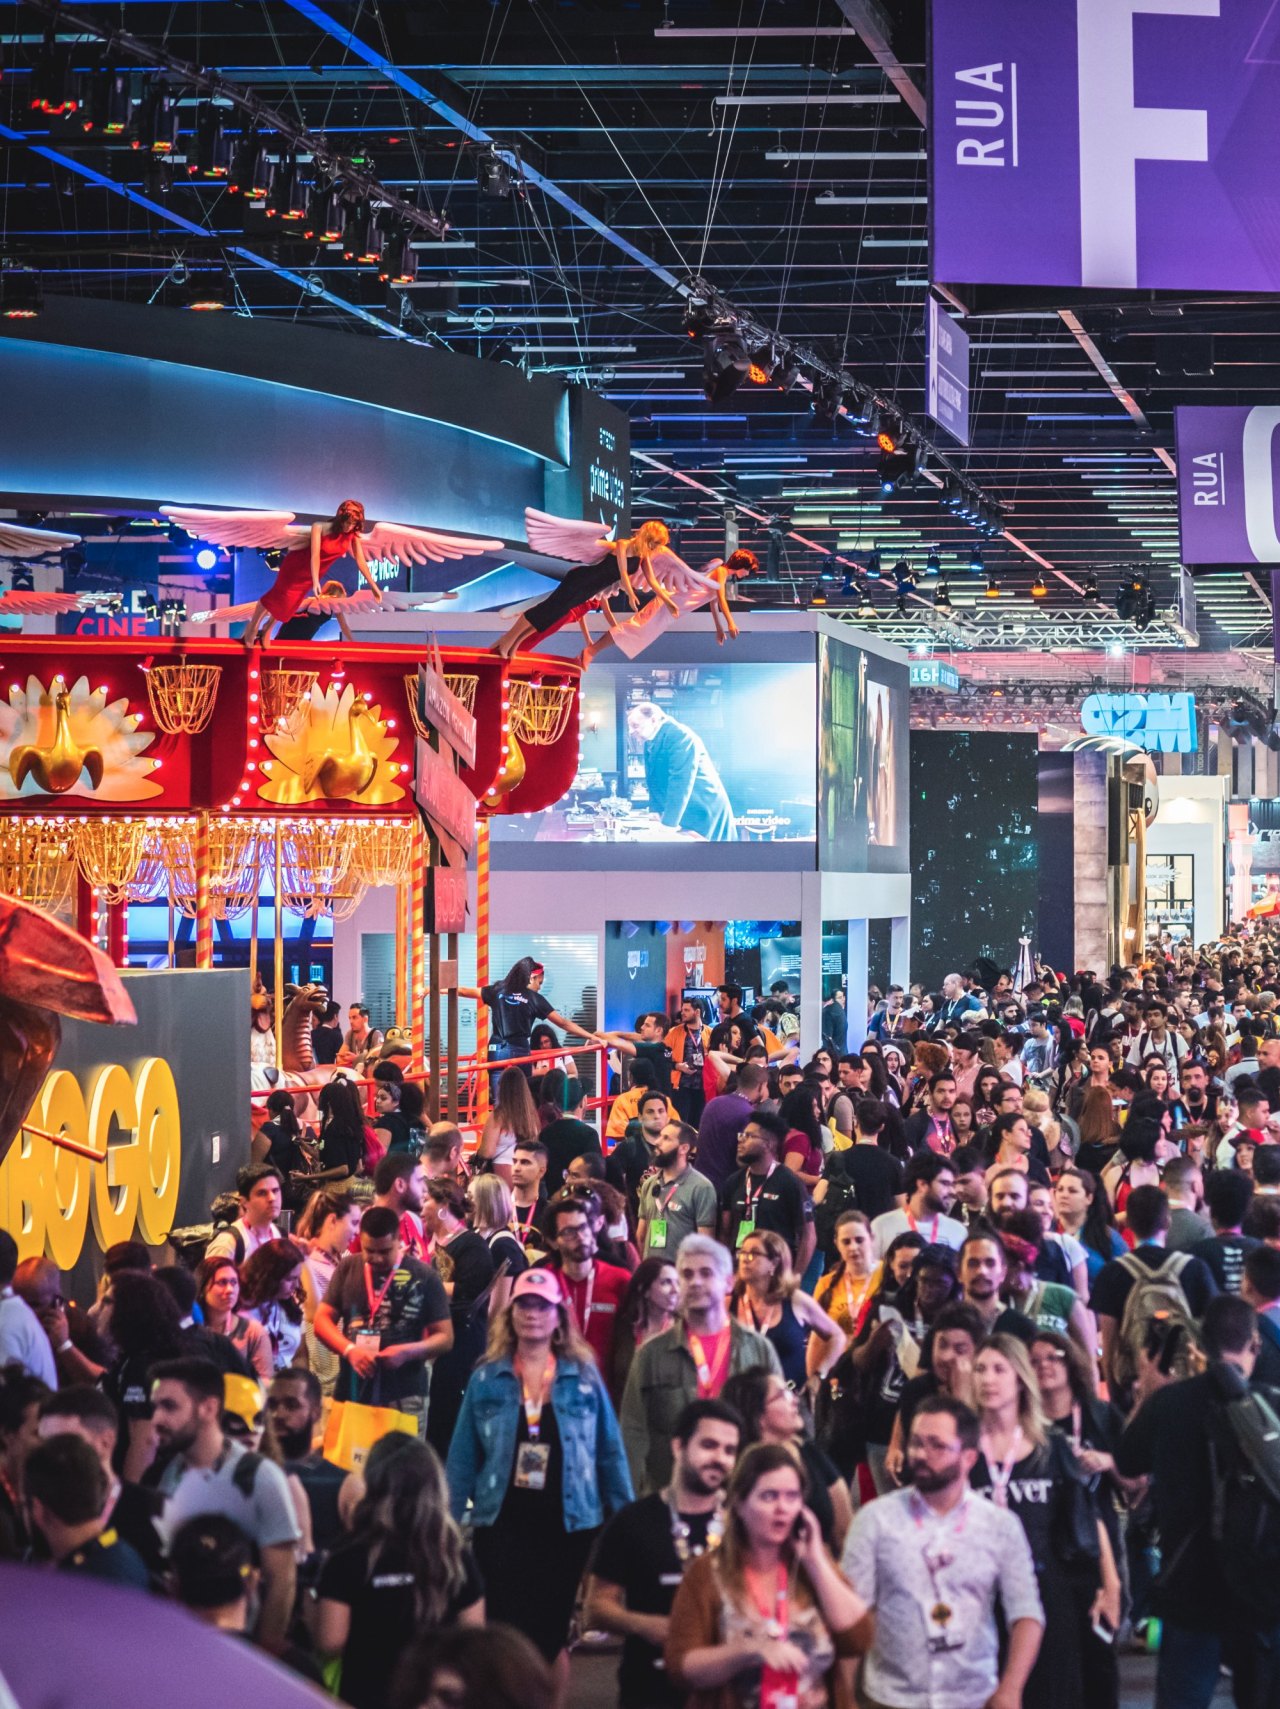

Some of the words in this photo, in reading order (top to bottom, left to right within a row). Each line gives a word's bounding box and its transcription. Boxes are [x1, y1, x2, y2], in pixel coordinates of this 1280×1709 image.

[955, 62, 1005, 167] RUA
[1077, 0, 1221, 288] F
[1193, 452, 1218, 505] RUA
